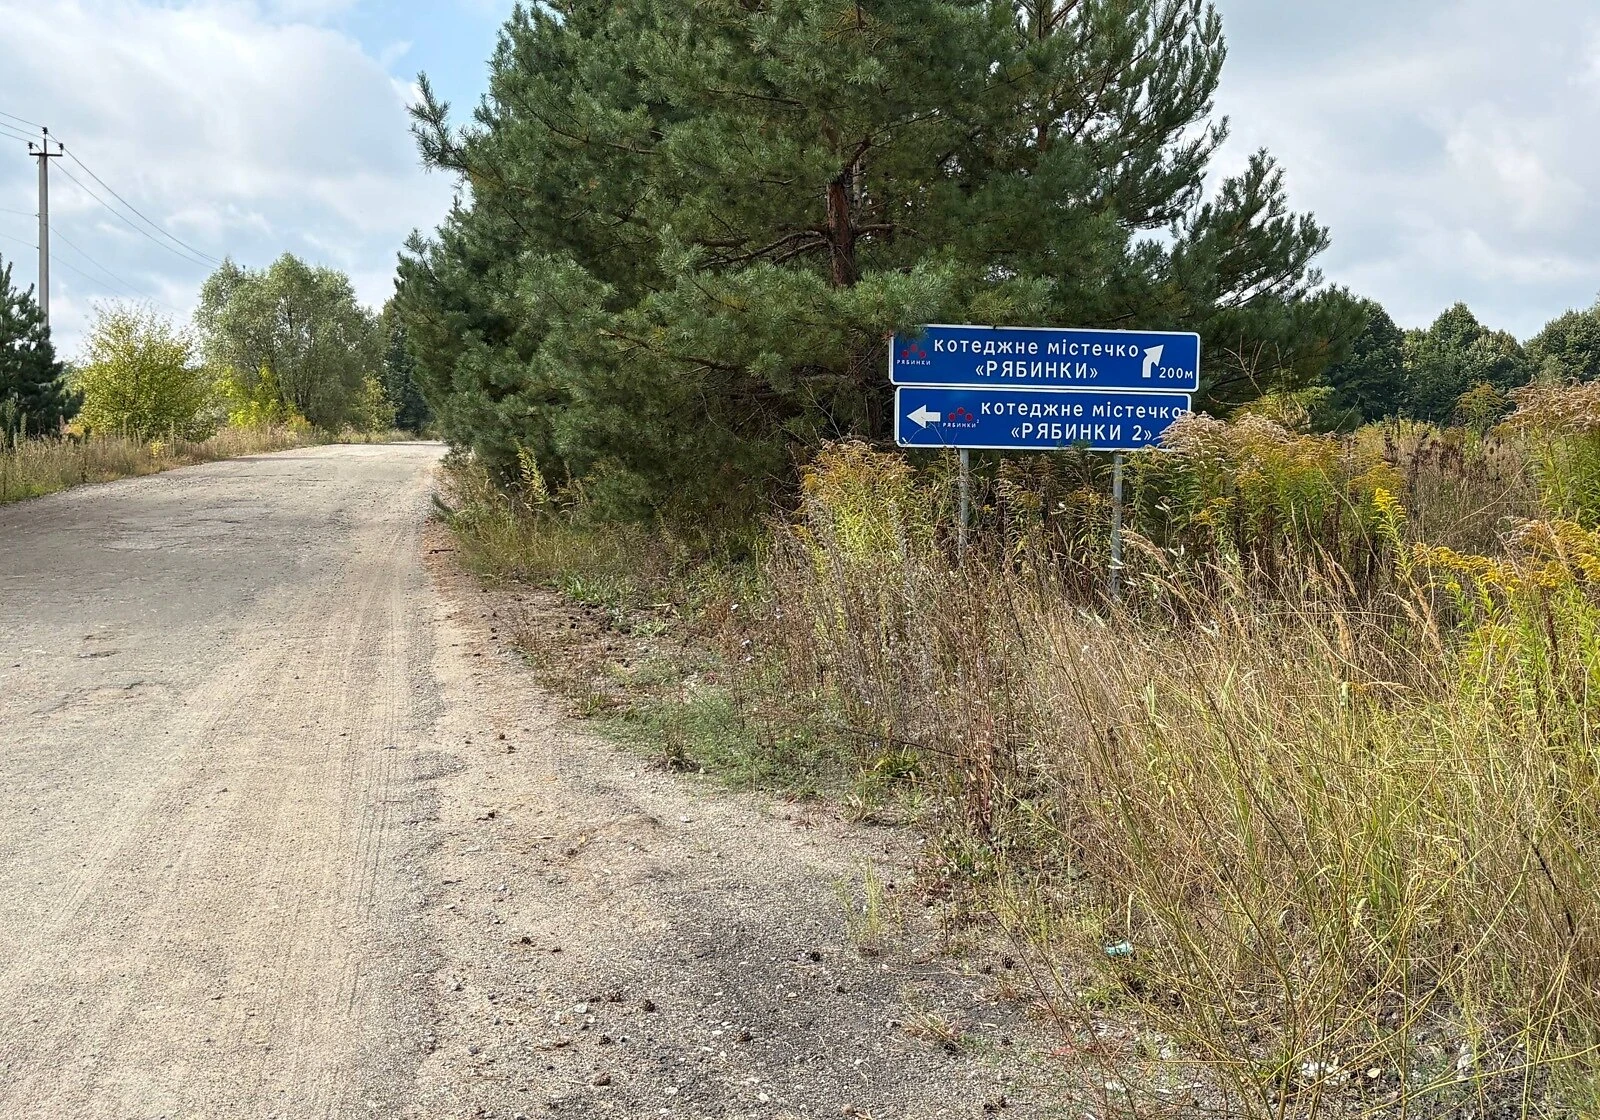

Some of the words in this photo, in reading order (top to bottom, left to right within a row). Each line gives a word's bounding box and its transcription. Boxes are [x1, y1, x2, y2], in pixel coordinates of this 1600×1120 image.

[934, 339, 1039, 356] котеджне
[1047, 339, 1139, 357] містечко
[975, 360, 1098, 379] «РЯБИНКИ»
[981, 402, 1083, 418] котеджне
[1092, 401, 1181, 419] містечко
[1011, 422, 1121, 440] «РЯБИНКИ
[1131, 425, 1152, 441] 2»
